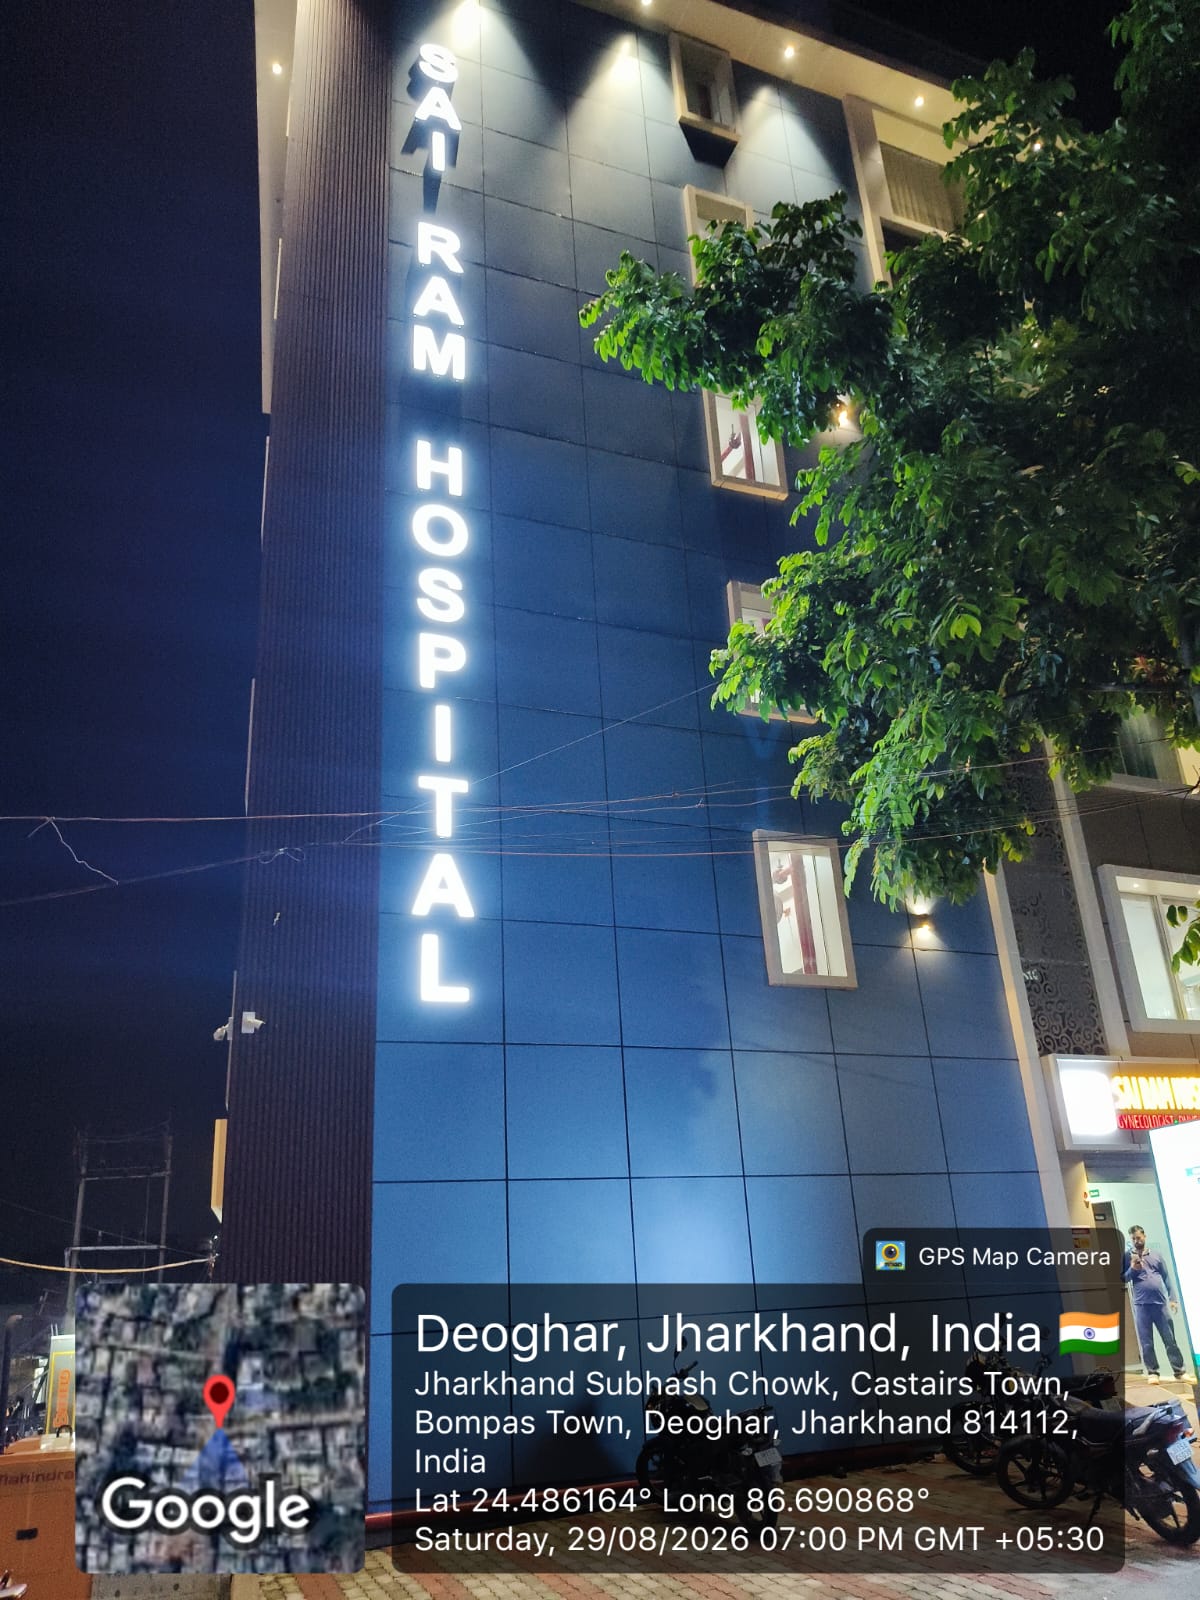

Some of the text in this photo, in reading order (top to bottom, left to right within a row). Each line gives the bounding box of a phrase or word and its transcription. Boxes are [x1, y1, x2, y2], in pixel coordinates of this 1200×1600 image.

[411, 43, 475, 1003] SAI RAM HOSPITAL
